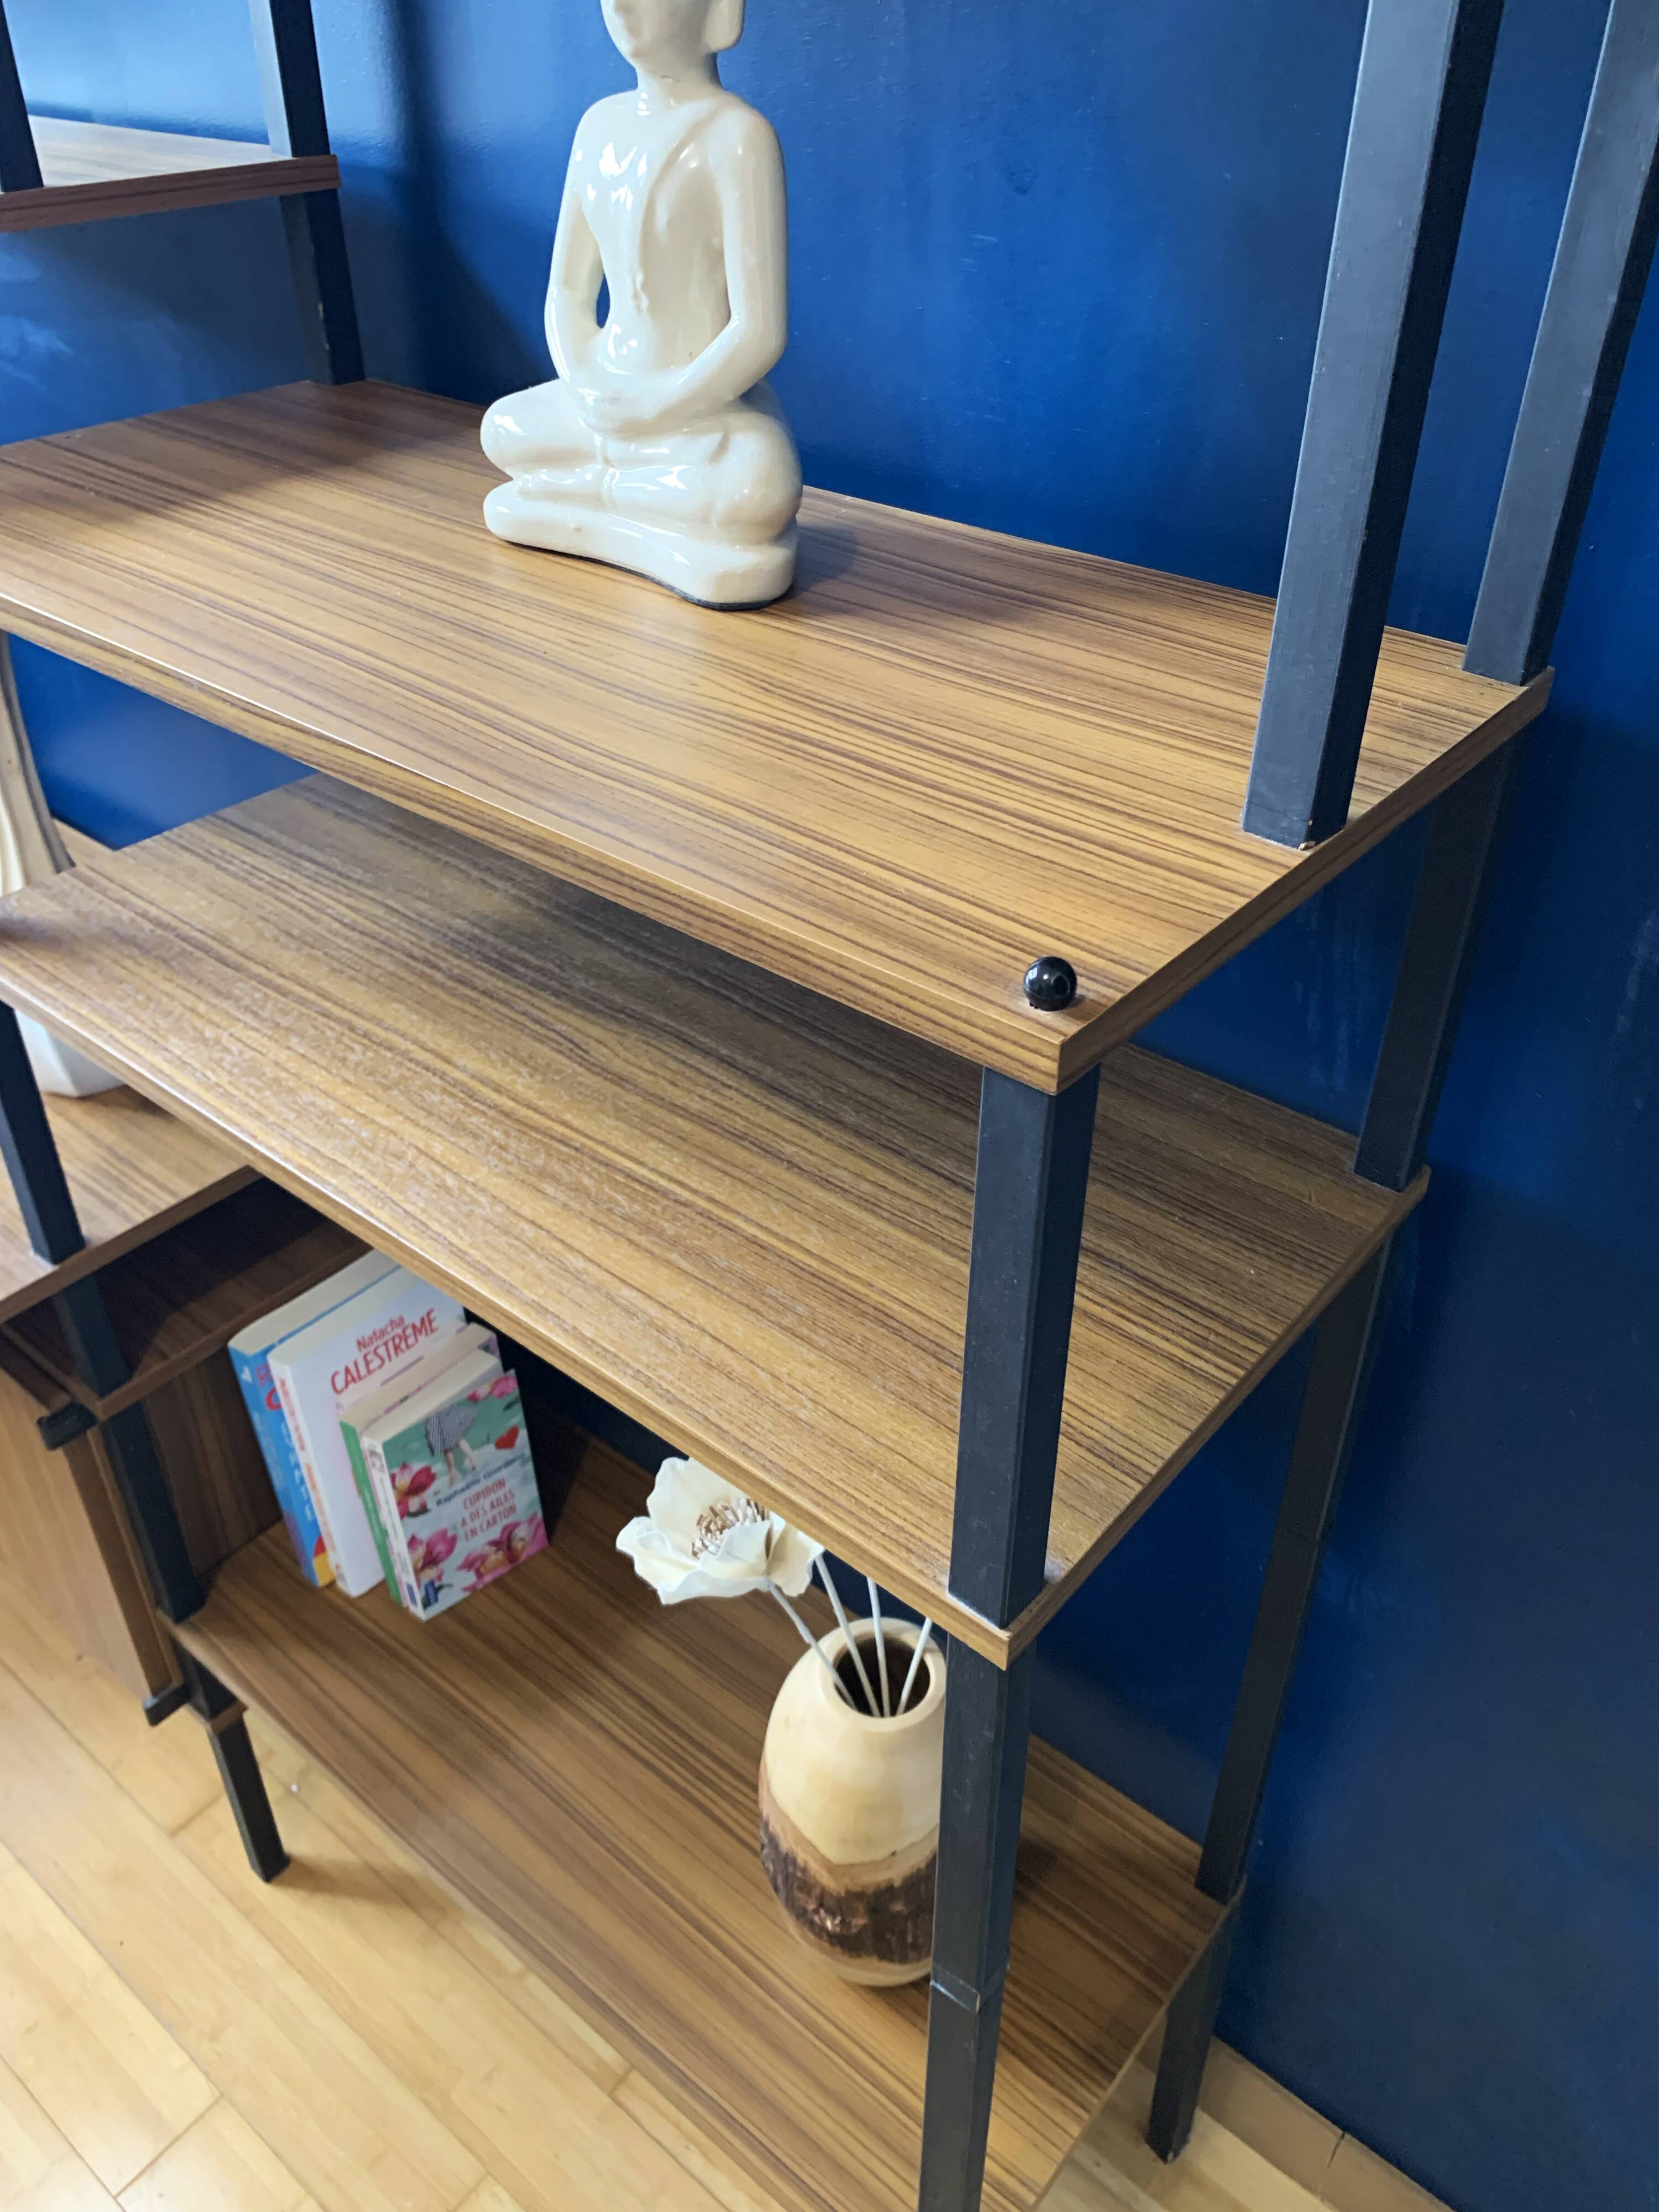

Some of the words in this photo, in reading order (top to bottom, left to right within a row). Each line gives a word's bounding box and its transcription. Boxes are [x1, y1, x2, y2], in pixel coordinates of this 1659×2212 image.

[356, 1314, 405, 1353] Natacha
[463, 1477, 506, 1510] CUPIDON
[469, 1506, 487, 1523] DES
[490, 1488, 515, 1511] AILES
[464, 1526, 478, 1542] EN
[479, 1504, 517, 1533] CARTON
